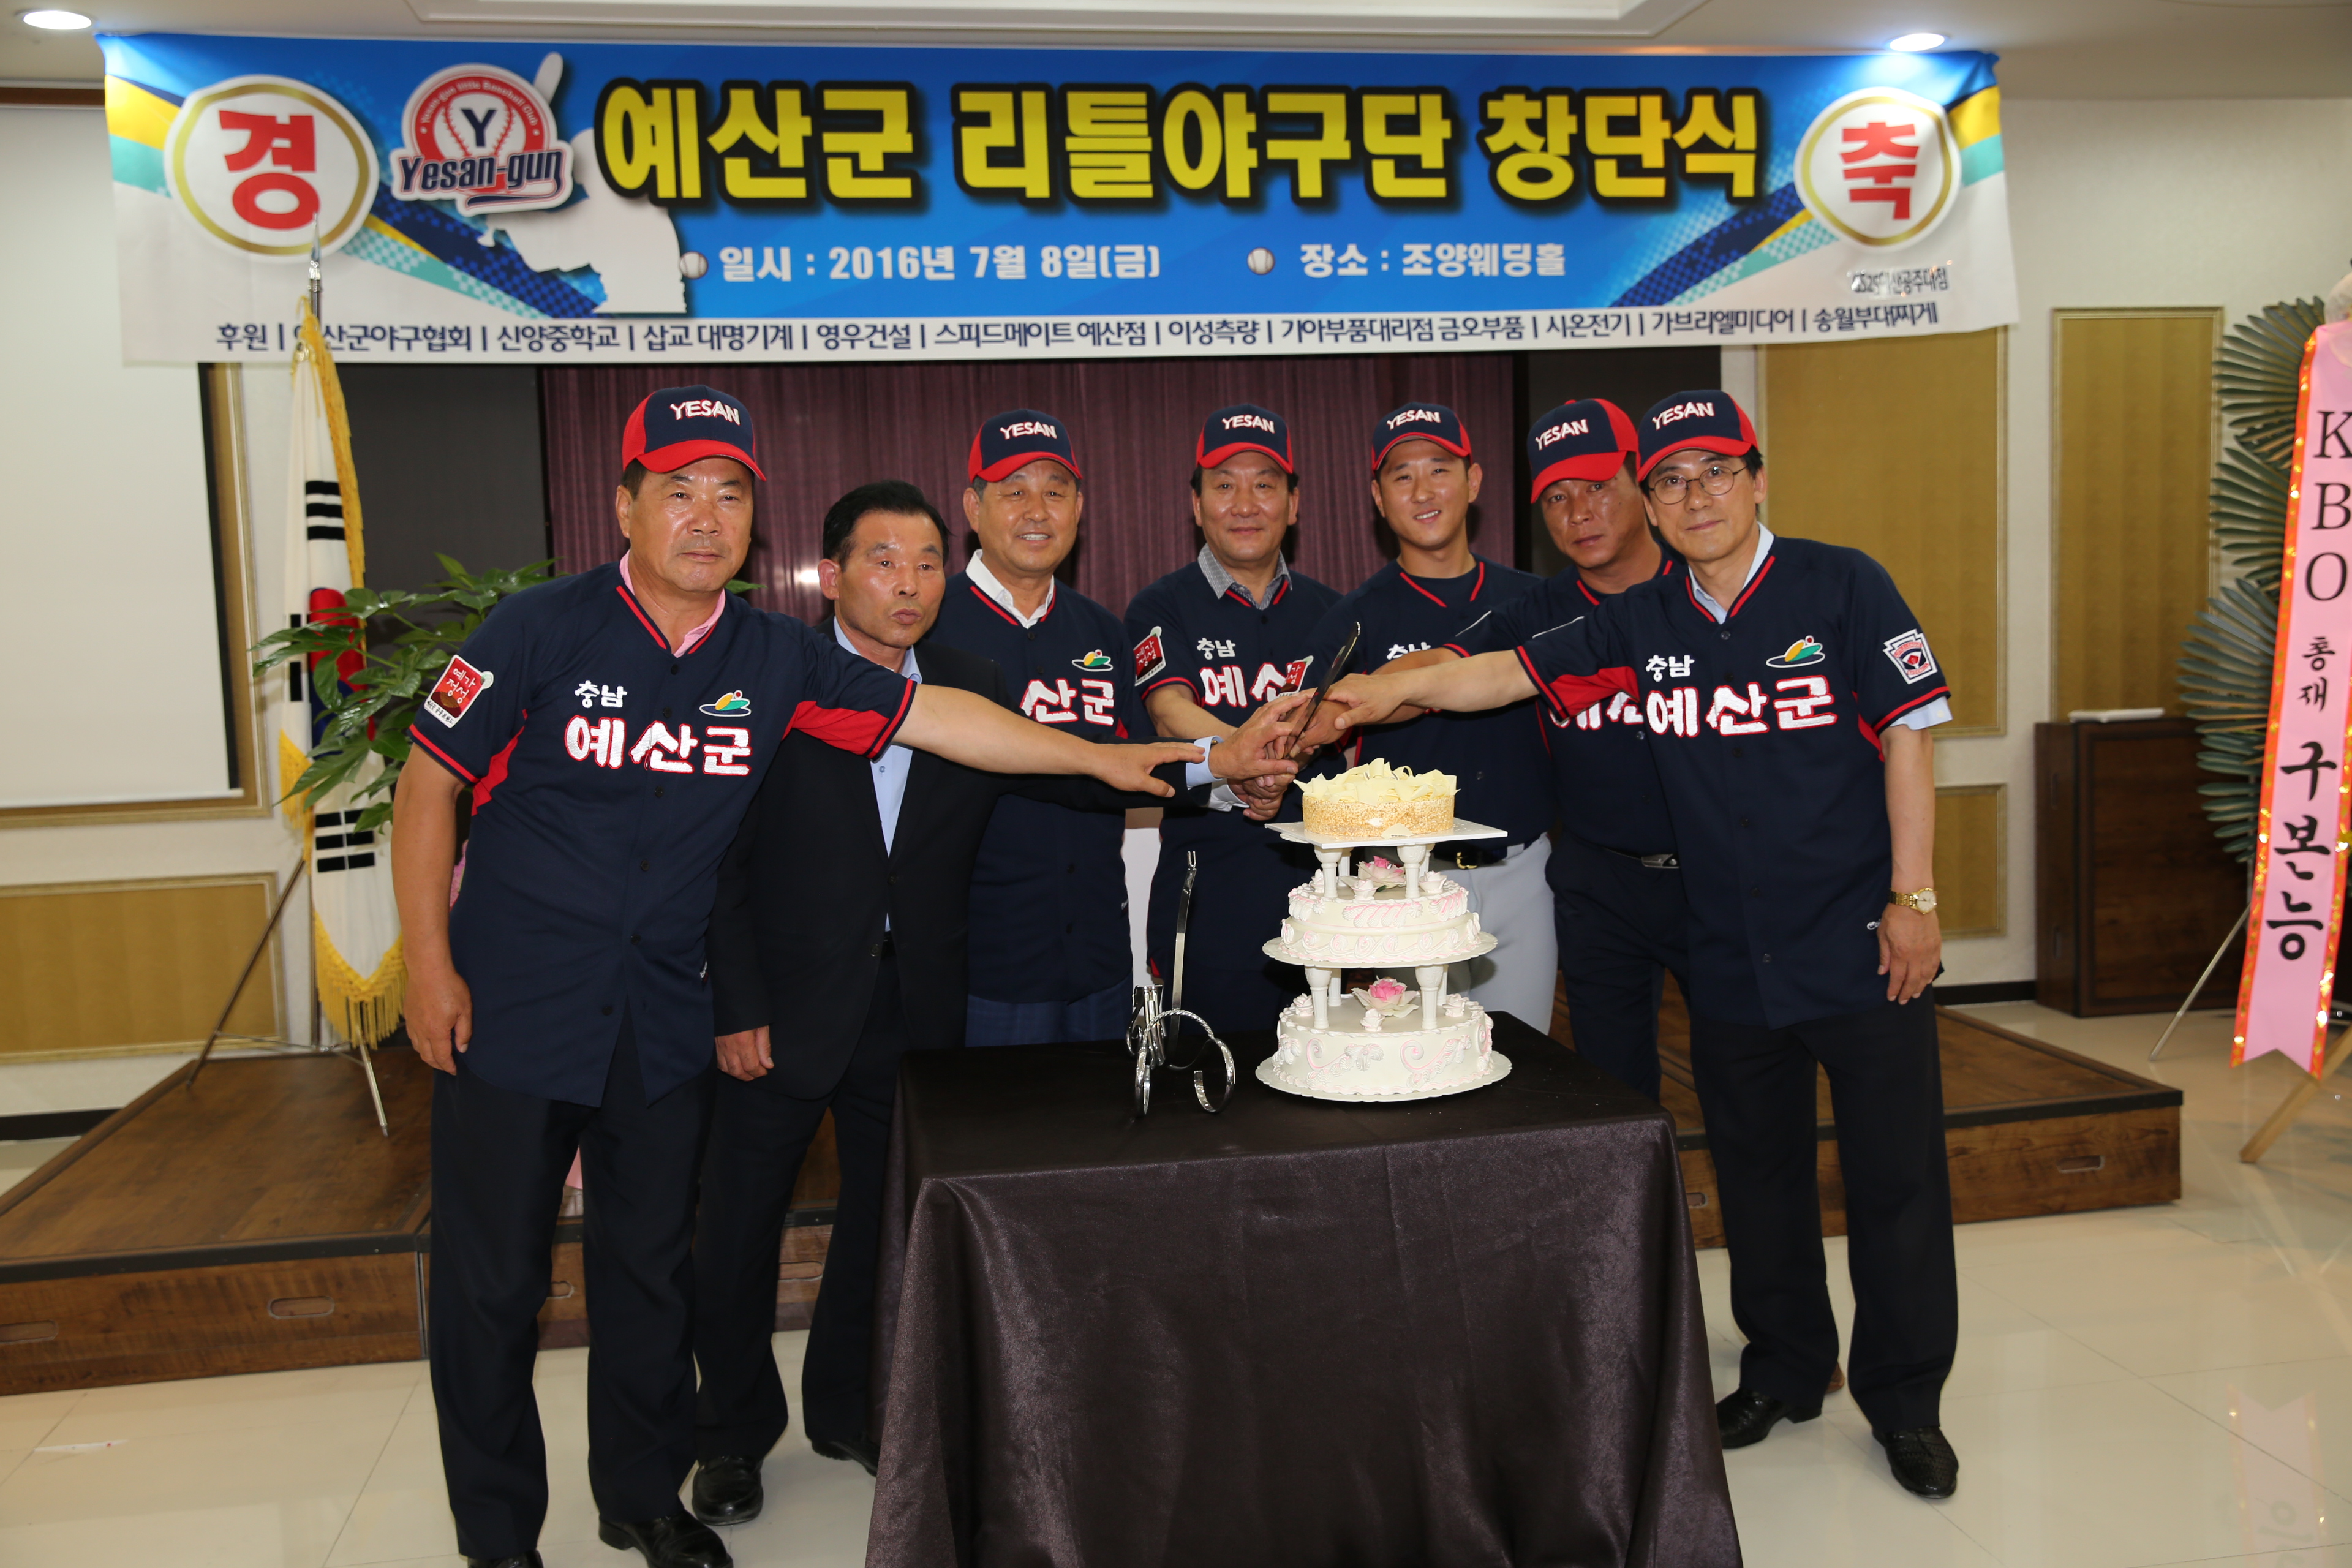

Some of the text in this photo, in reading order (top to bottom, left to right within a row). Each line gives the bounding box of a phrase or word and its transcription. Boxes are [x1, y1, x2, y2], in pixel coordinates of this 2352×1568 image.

[461, 109, 497, 148] Y
[603, 86, 1758, 200] 예산군 리틀야구단 창단식
[219, 110, 321, 230] 경
[400, 150, 564, 195] Yesan-gun
[1841, 122, 1920, 221] 축
[719, 247, 792, 281] 일시
[829, 246, 955, 281] 2016년
[970, 246, 1027, 279] 7월
[1041, 245, 1160, 279] 8일(금)
[1300, 243, 1369, 277] 장소
[1402, 243, 1566, 277] 조양웨딩홀
[1281, 317, 1525, 344] 기아부품대리점 금오부품
[1547, 313, 1632, 339] 시온전기
[1652, 309, 1795, 337] 가브리엘미디어
[1813, 303, 1938, 333] 송월부대찌게
[217, 323, 474, 352] 후원 산군야구협회
[497, 325, 620, 352] 신양중학교
[698, 325, 793, 350] 대명기계
[816, 324, 911, 350] 영우건설
[935, 322, 1146, 348] 스피드메이트 예산점
[1168, 320, 1261, 345] 이성측량
[669, 399, 741, 426] YESAN
[1221, 414, 1275, 434] YESAN
[1386, 410, 1441, 431] YESAN
[1653, 402, 1714, 430] YESAN
[999, 421, 1058, 440] YESAN
[1534, 419, 1589, 451] YESAN
[1196, 638, 1236, 660] 충남
[453, 668, 477, 688] 예가
[1645, 655, 1694, 681] 충남
[446, 678, 469, 704] 정성
[574, 680, 628, 709] 충남
[1646, 676, 1836, 737] 예산군
[565, 715, 751, 775] 예산군
[2266, 742, 2337, 960] 구본능
